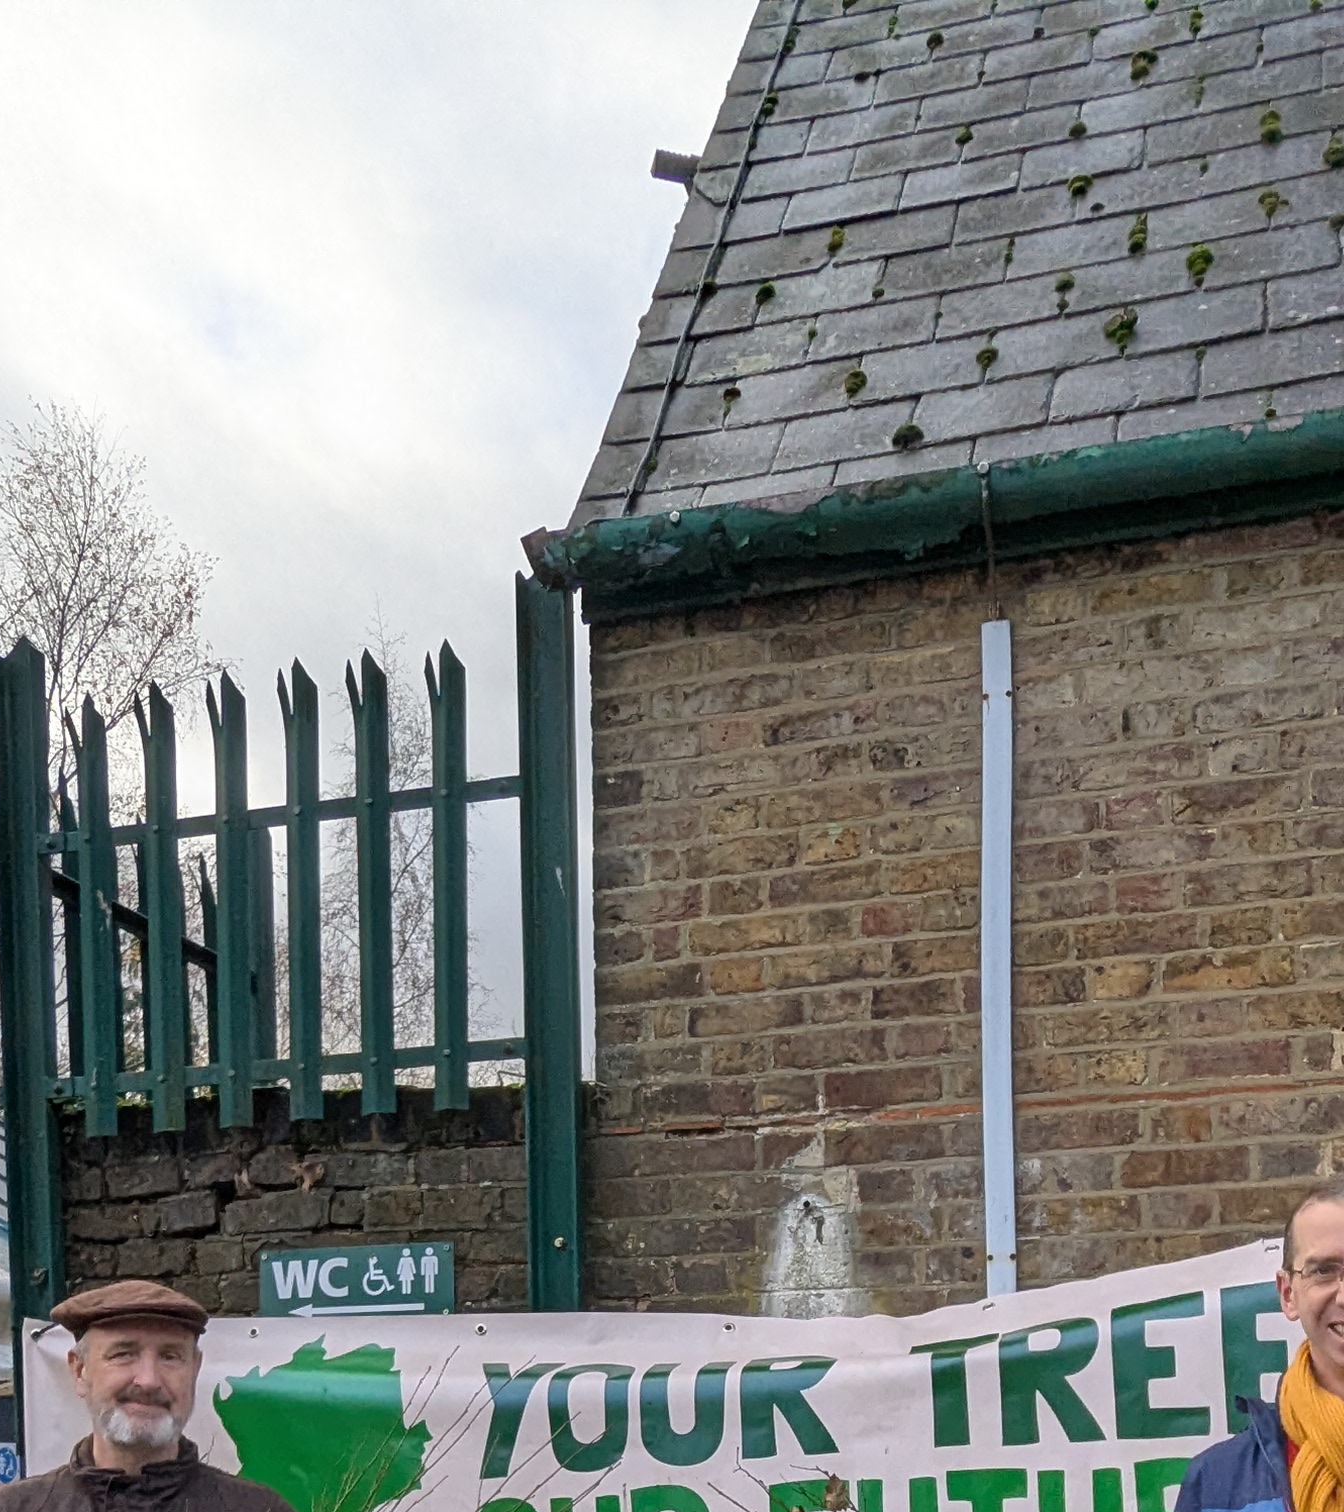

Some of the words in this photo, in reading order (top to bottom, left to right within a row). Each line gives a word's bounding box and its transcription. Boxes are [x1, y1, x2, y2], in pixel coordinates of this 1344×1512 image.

[272, 1257, 349, 1299] WC
[480, 1355, 840, 1479] YOUR
[910, 1280, 1289, 1447] TREE
